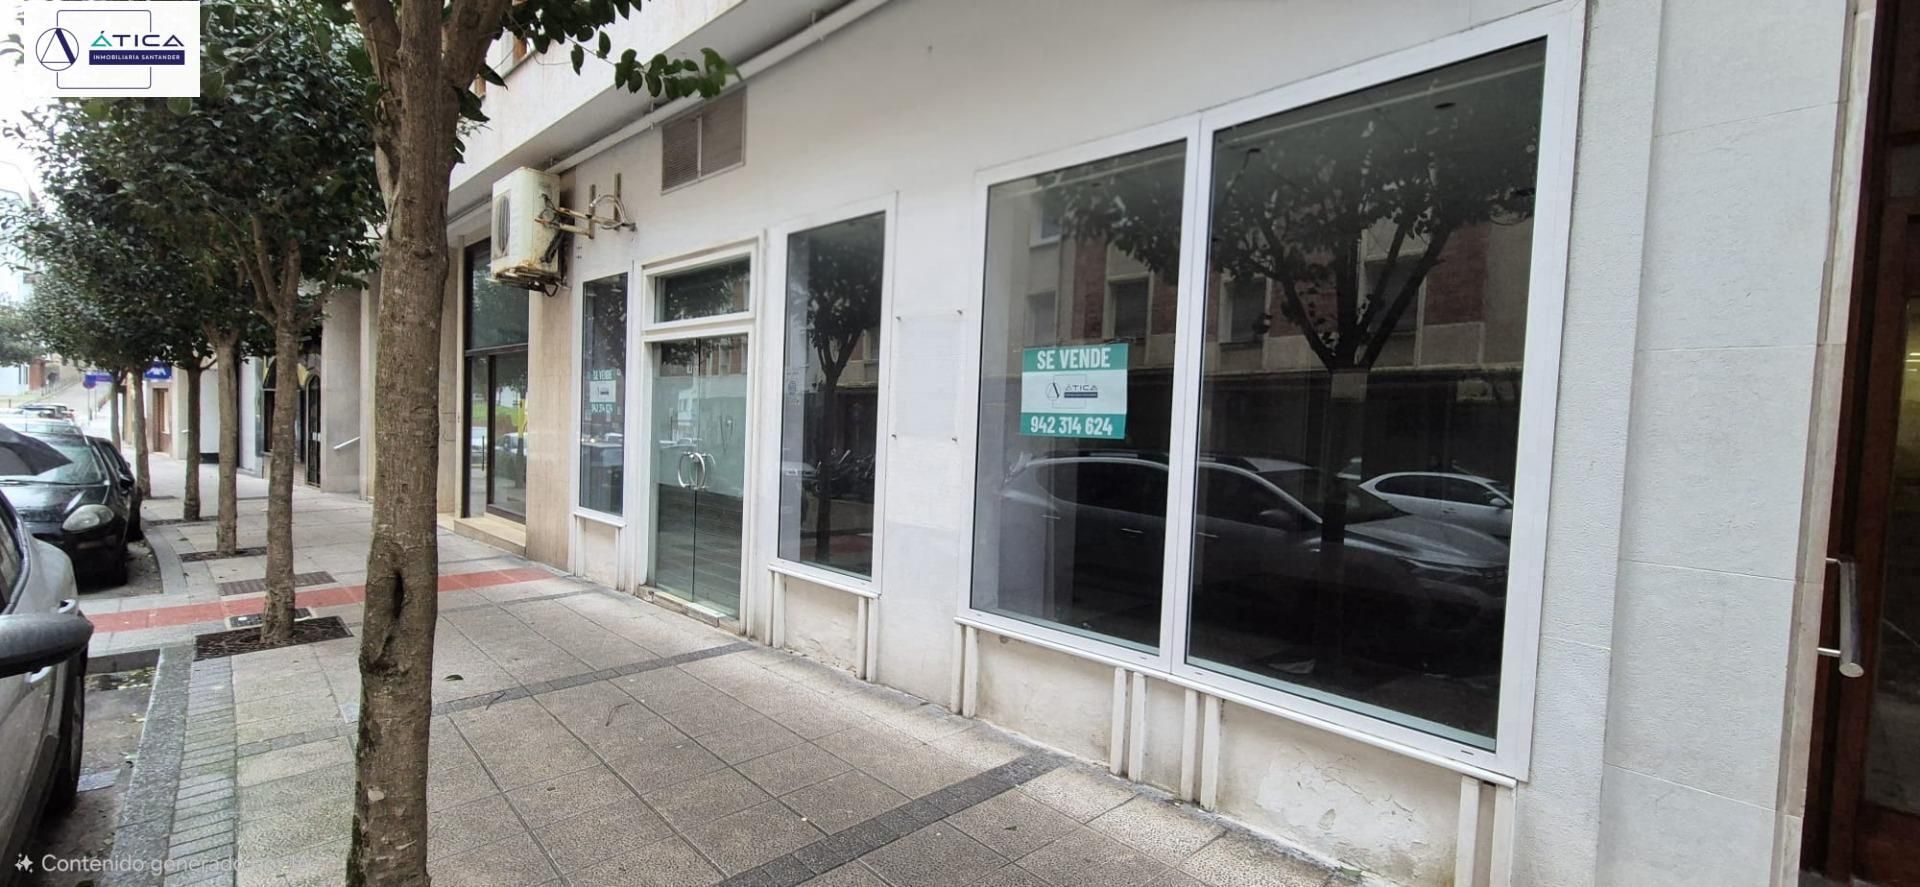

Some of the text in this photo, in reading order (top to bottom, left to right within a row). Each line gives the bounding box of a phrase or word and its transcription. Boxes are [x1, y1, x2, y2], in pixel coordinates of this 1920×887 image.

[1037, 347, 1112, 370] SE VENDE
[1030, 415, 1113, 436] 942 314 624
